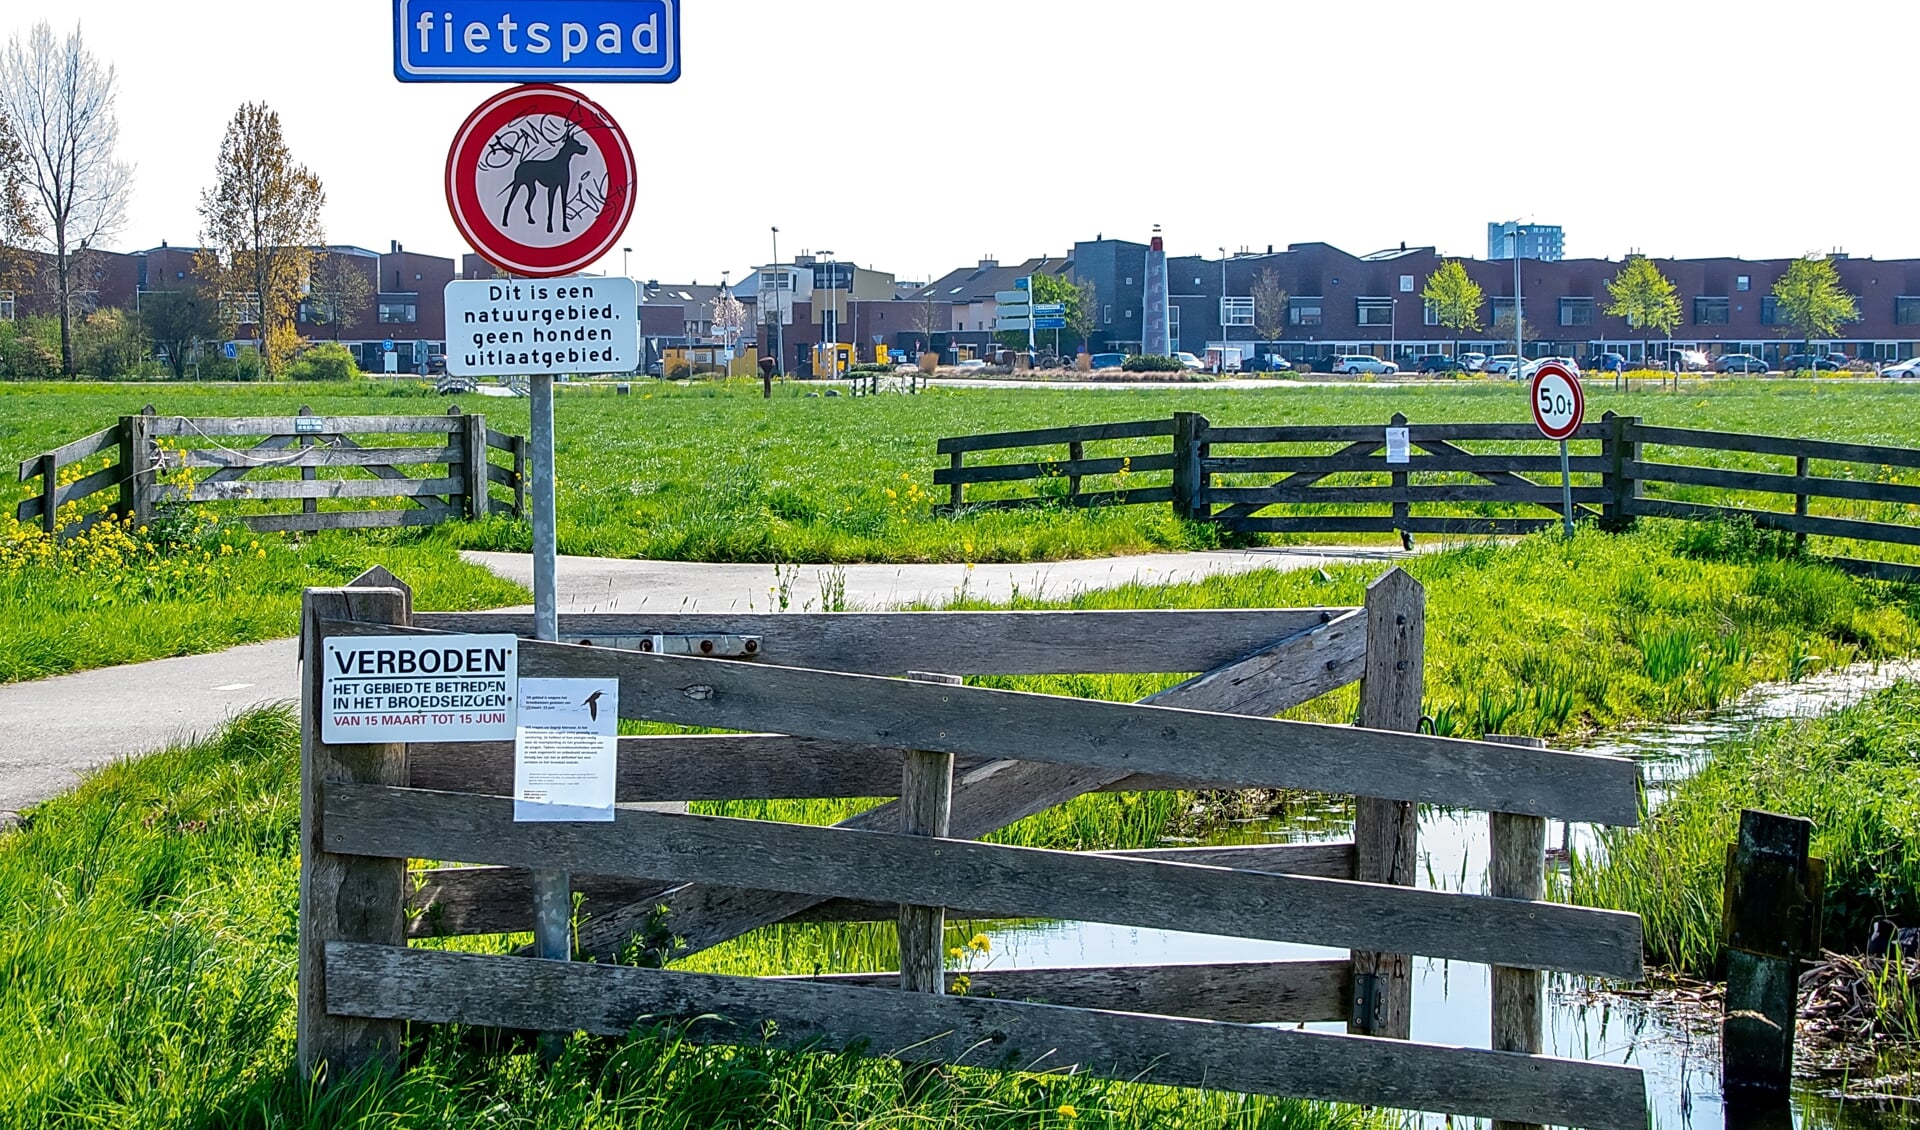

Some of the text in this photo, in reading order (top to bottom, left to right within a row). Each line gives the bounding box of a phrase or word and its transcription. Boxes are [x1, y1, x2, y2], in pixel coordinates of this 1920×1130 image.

[416, 12, 658, 63] fietspad
[490, 285, 593, 301] Dit is een
[473, 326, 611, 349] geen honden
[465, 346, 620, 368] uitlaatgebied.
[335, 649, 505, 674] VERBODEN
[334, 681, 505, 695] HET GEBIED TE BETREDEN
[334, 695, 505, 709] IN HET BROEDSEIZOEN
[334, 713, 505, 725] VAN 15 MAART TOT 15 JUNI
